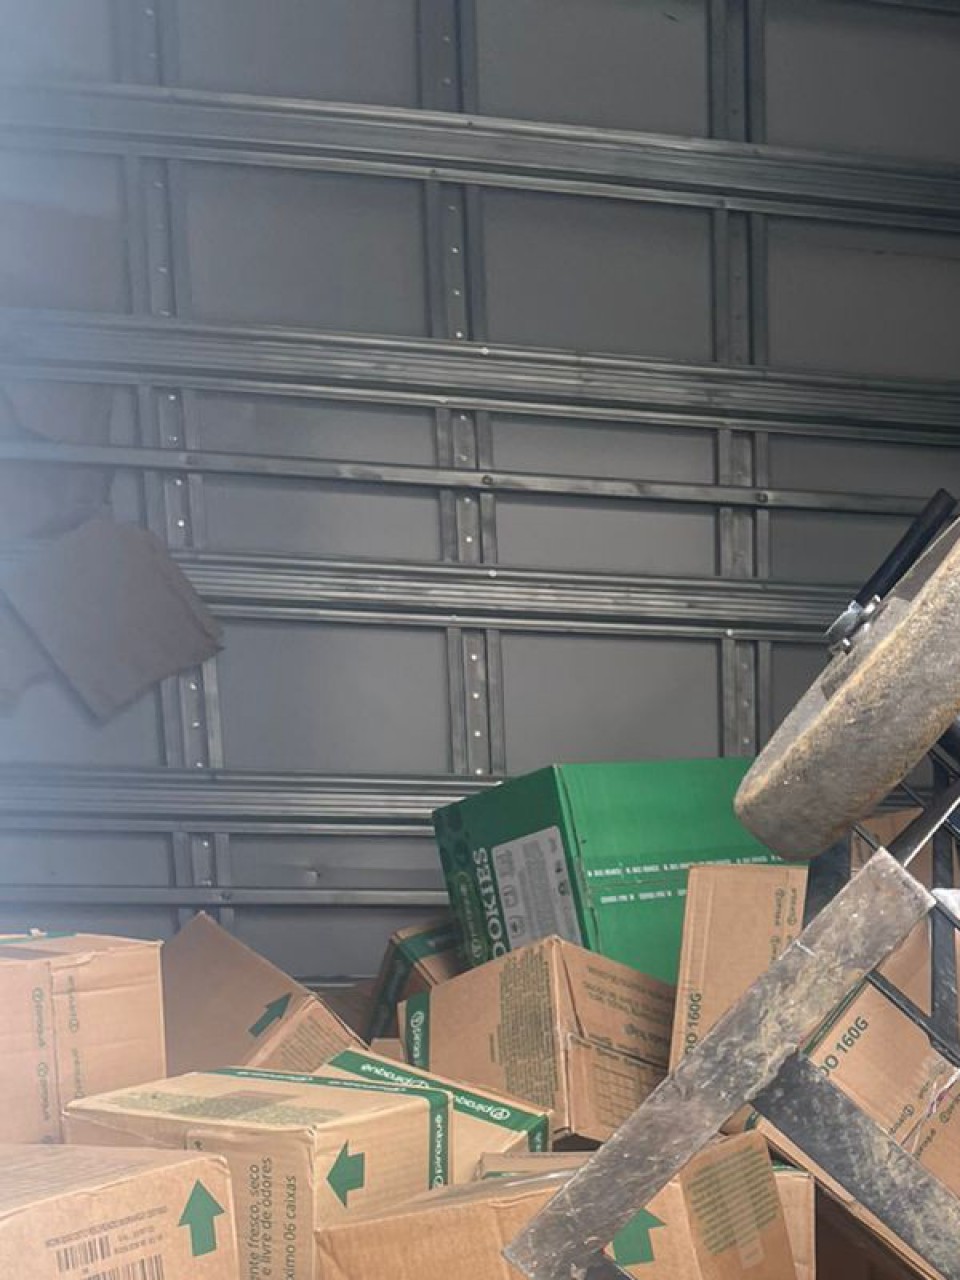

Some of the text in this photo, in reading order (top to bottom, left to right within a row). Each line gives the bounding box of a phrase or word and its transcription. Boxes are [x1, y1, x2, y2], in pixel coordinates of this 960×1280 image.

[841, 1016, 869, 1054] 160G
[453, 1095, 492, 1113] piraq
[249, 1164, 260, 1197] seco
[260, 1158, 273, 1208] odores
[284, 1175, 297, 1220] caixas
[260, 1210, 273, 1231] de
[283, 1223, 297, 1242] 06
[260, 1233, 272, 1265] livre
[262, 1267, 272, 1276] e
